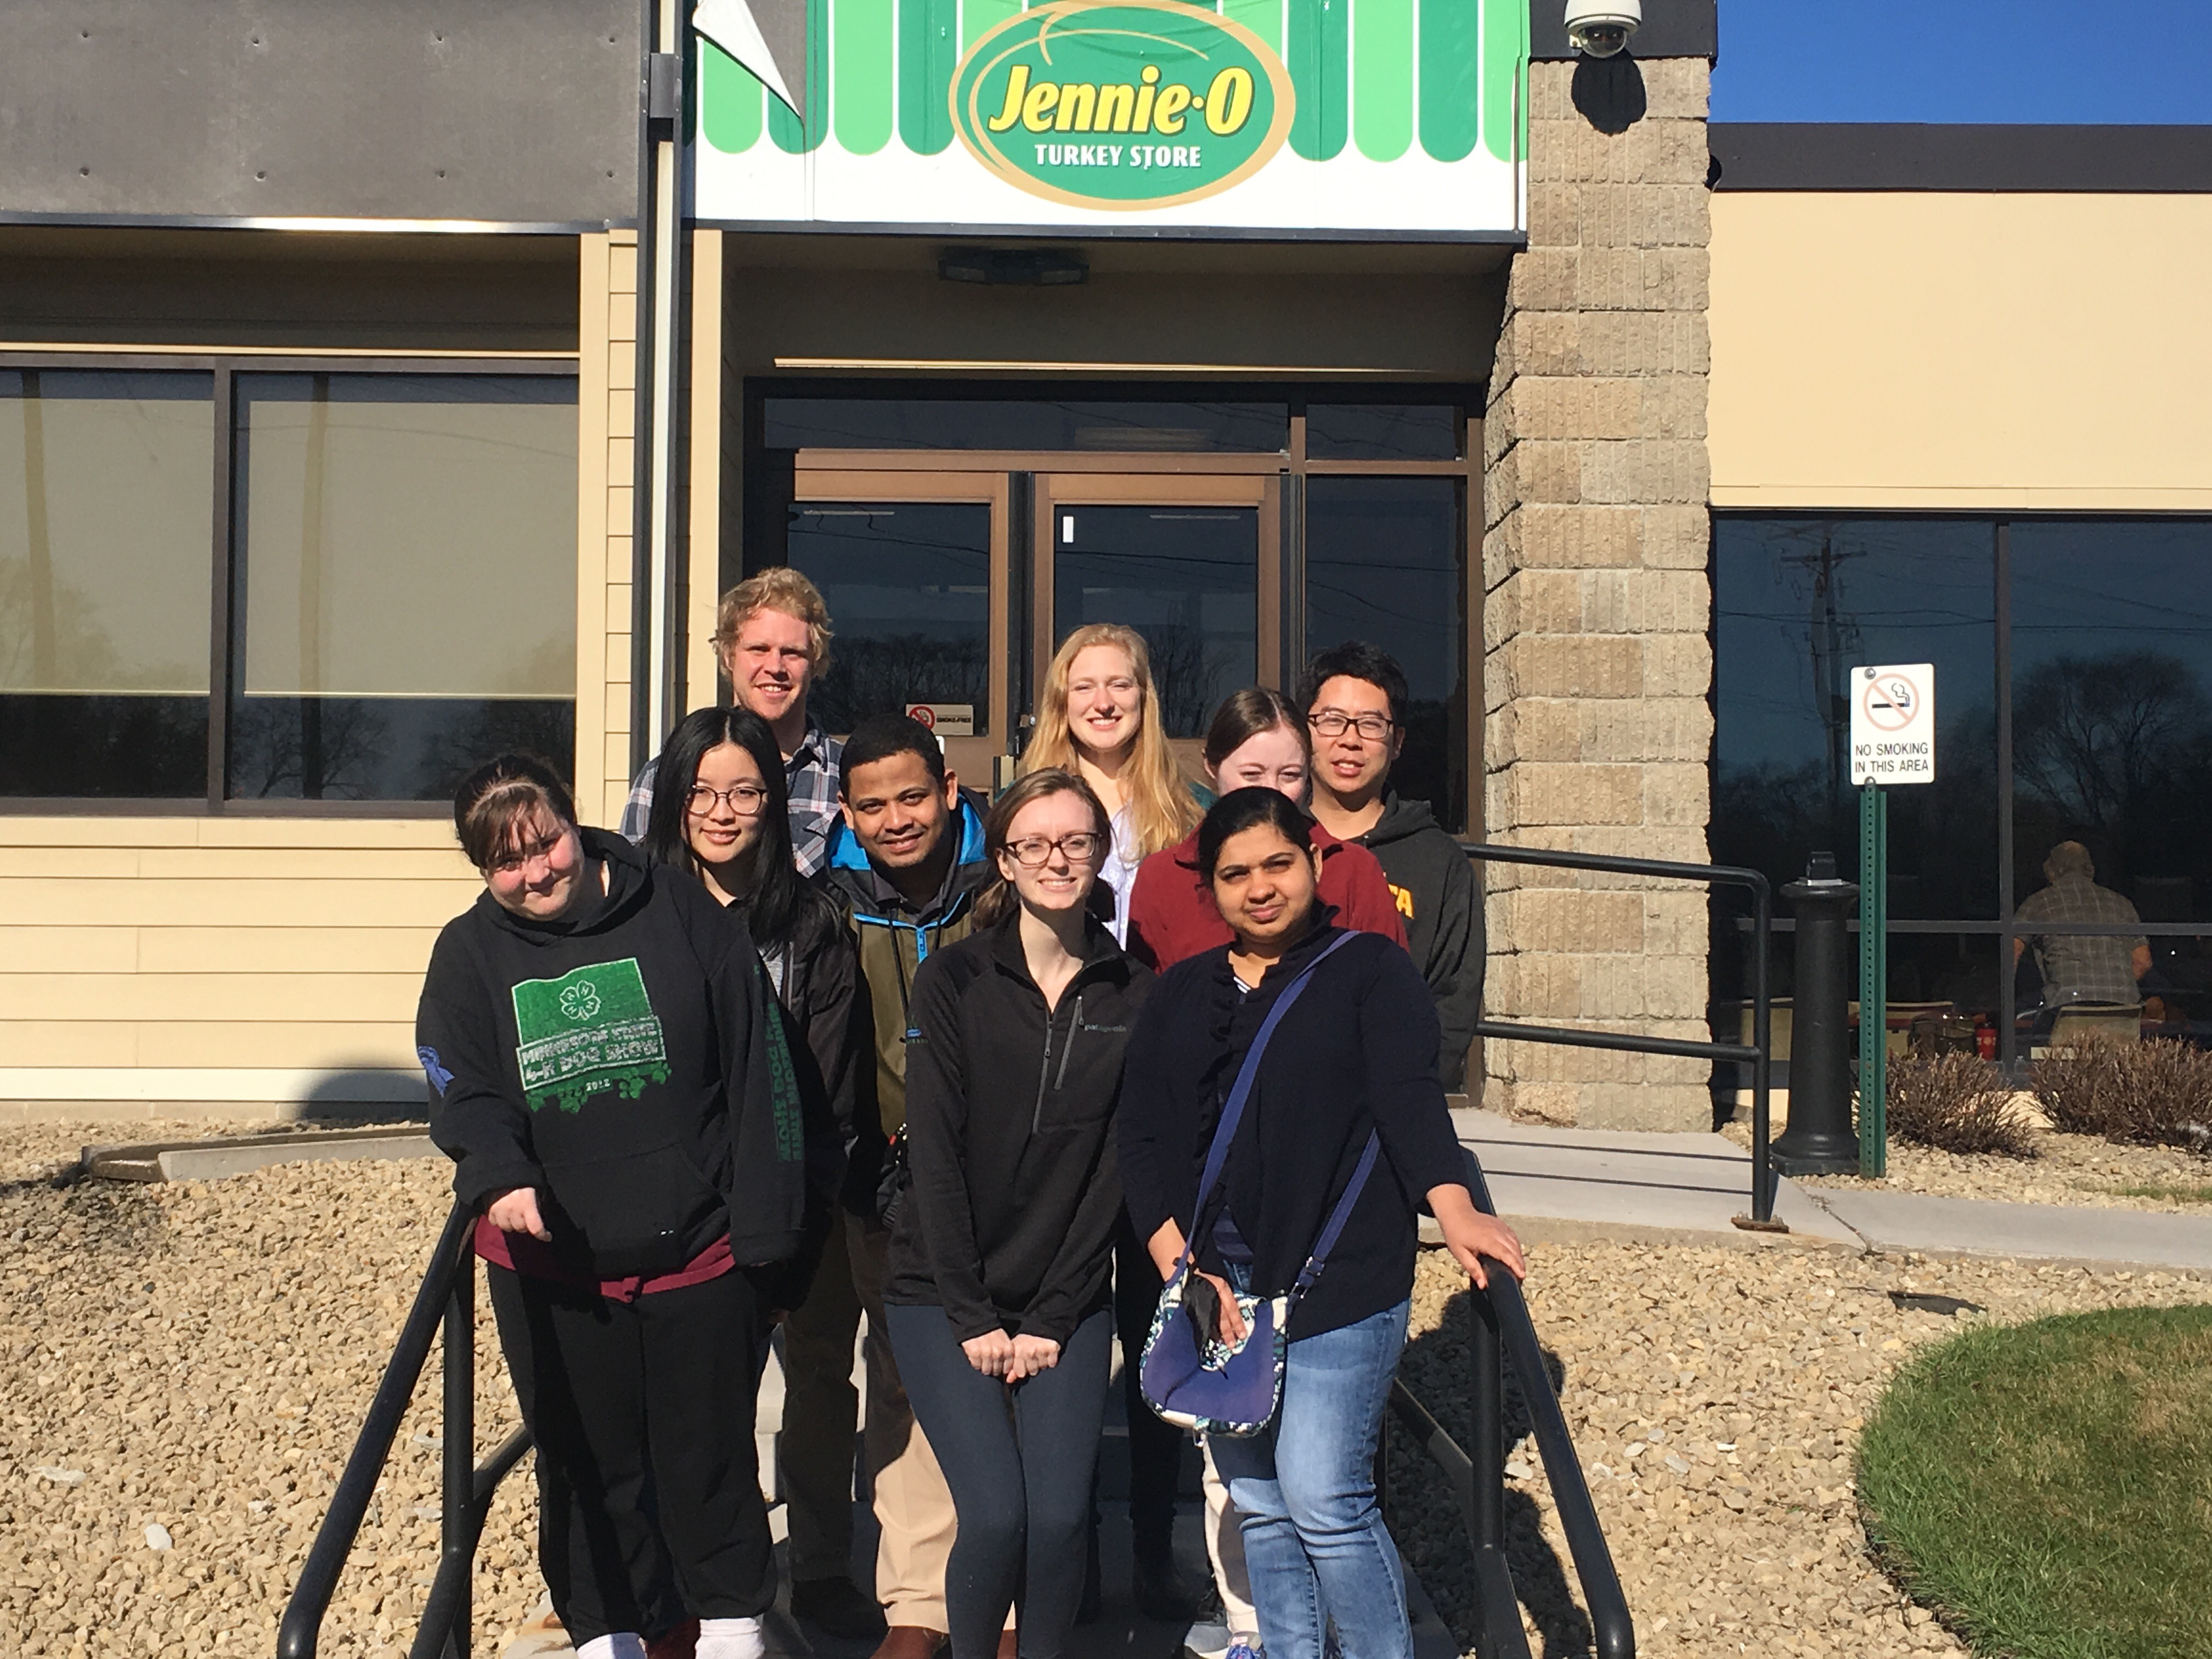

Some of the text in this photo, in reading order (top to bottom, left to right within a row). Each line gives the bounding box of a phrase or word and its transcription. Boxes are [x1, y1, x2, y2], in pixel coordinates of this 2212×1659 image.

[1035, 144, 1201, 168] TURKEY STORE
[1855, 742, 1928, 756] NO SMOKING
[1855, 759, 1929, 772] IN THIS AREA
[526, 1039, 659, 1081] 4-H DOG SHOW
[774, 1099, 792, 1162] SHOW
